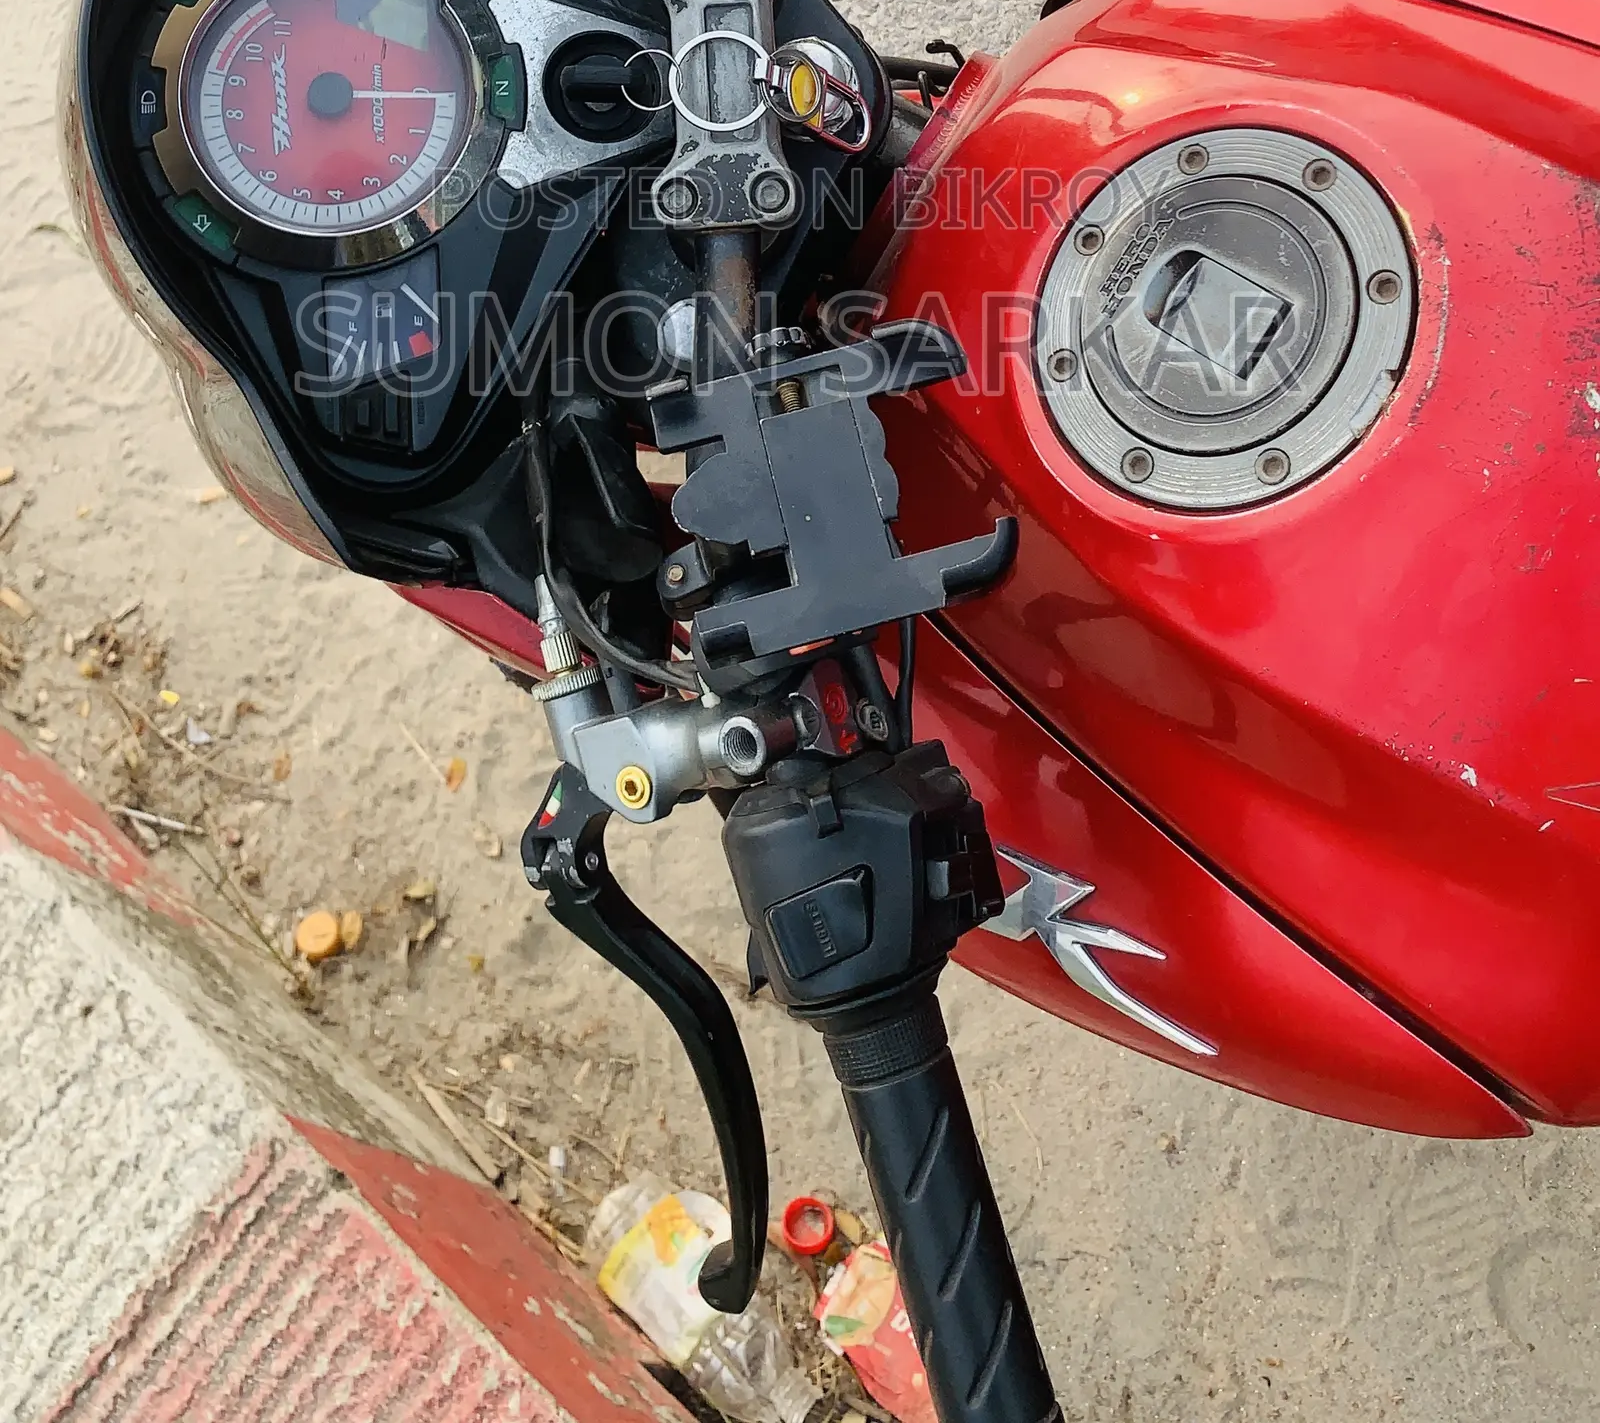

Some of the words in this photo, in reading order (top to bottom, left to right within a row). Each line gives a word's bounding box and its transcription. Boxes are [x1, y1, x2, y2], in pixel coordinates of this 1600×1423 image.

[274, 20, 292, 36] 11
[245, 43, 264, 62] 10
[228, 75, 247, 87] 9
[495, 80, 509, 96] N
[372, 64, 386, 144] x1000/min
[226, 109, 244, 121] 8
[237, 142, 257, 154] 7
[390, 154, 407, 166] 2
[259, 170, 278, 182] 6
[362, 176, 381, 188] 3
[292, 188, 311, 200] 5
[327, 189, 345, 201] 4
[1099, 222, 1152, 297] HERO
[1101, 218, 1174, 319] HONDA
[348, 321, 358, 333] F
[413, 315, 423, 327] E
